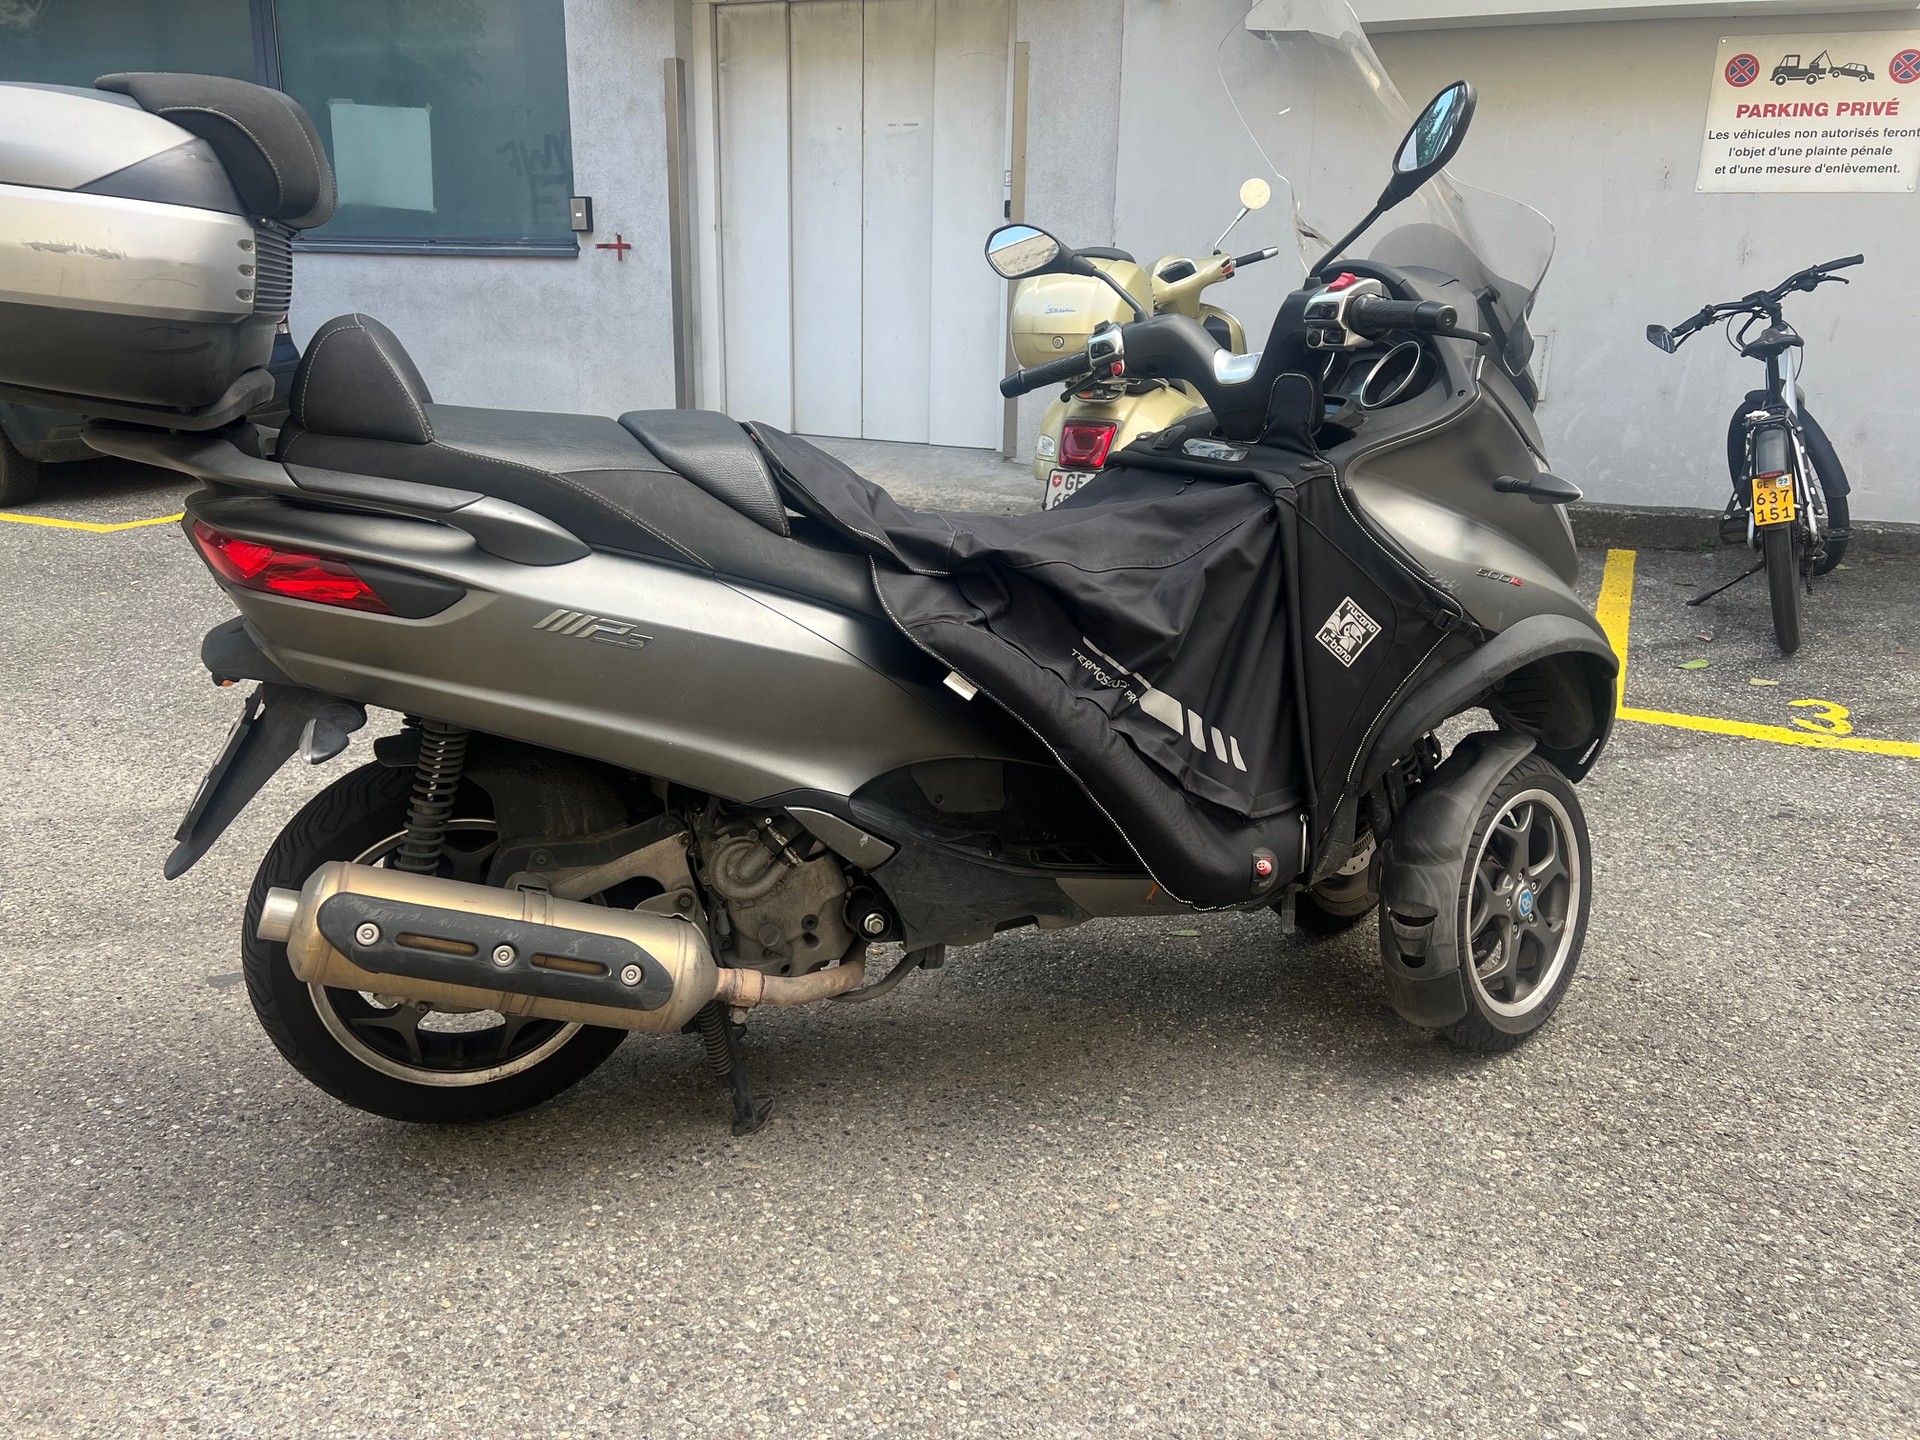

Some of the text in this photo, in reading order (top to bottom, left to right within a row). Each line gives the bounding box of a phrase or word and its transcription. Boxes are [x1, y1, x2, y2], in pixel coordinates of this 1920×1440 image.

[1736, 97, 1900, 118] PARKING PRIVÉ
[1708, 127, 1920, 140] Les véhicules non autorisés feront
[1728, 145, 1893, 159] l'objet d'une plainte pénale
[1714, 163, 1901, 174] et d'une mesure d'enlèvement.
[1065, 473, 1087, 490] GE
[1756, 481, 1769, 489] GE
[1756, 490, 1790, 505] 637
[1757, 506, 1791, 522] 151
[1787, 698, 1853, 735] 3
